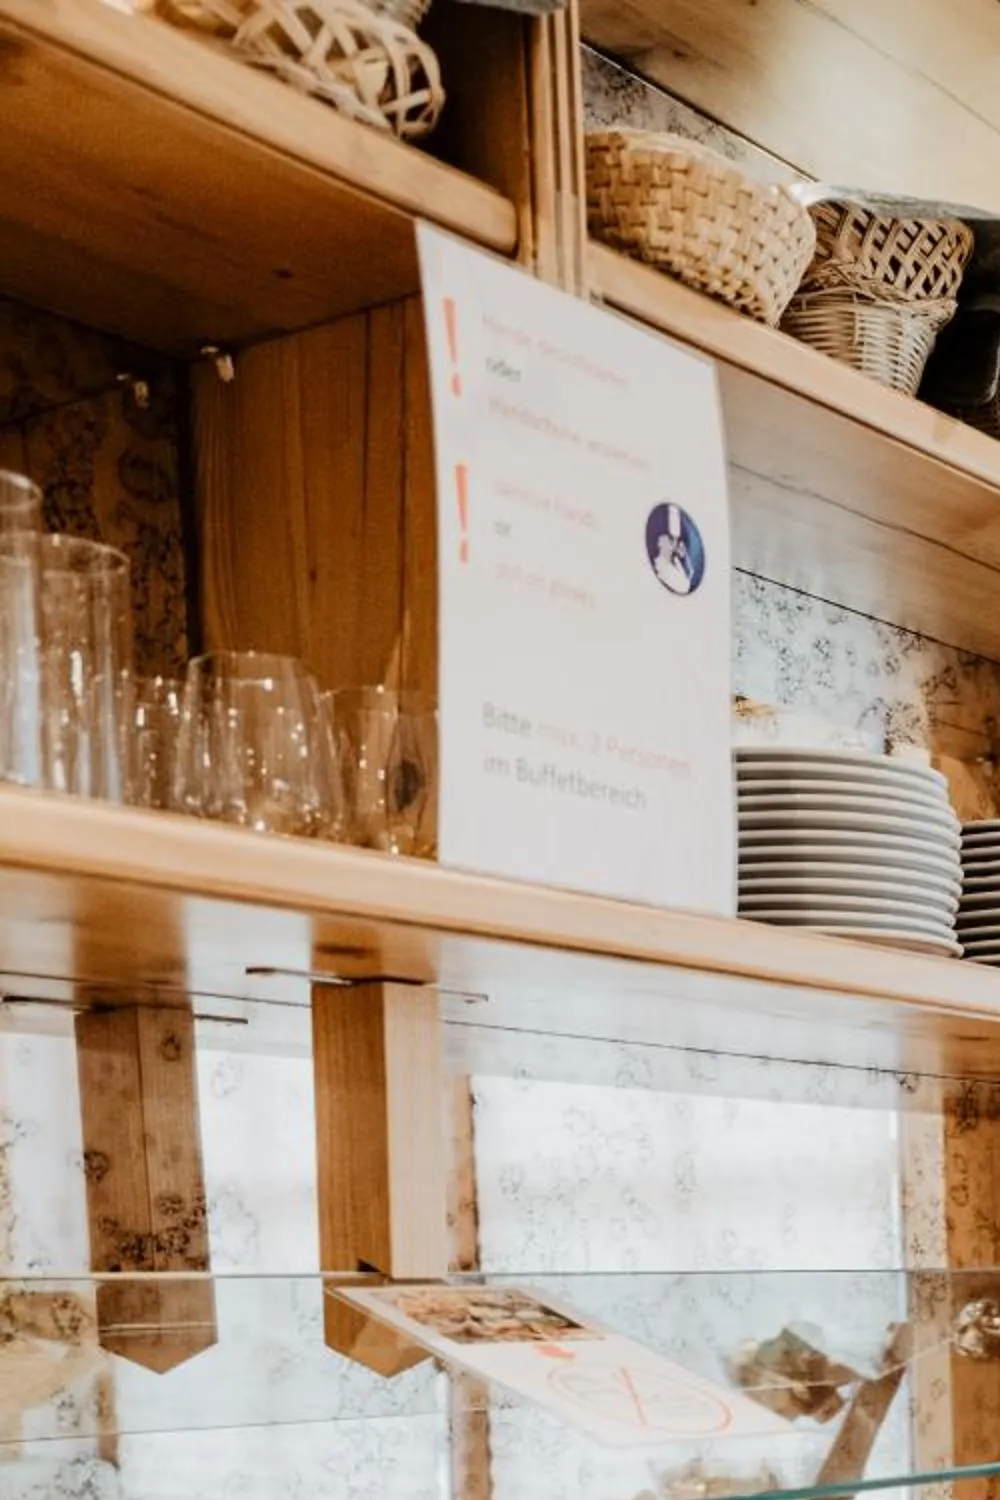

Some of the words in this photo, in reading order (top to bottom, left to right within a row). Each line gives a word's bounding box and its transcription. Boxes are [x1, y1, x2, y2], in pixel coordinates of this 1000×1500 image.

[481, 700, 533, 738] Bitte
[483, 751, 510, 778] im
[515, 755, 648, 812] Buffetbereich
